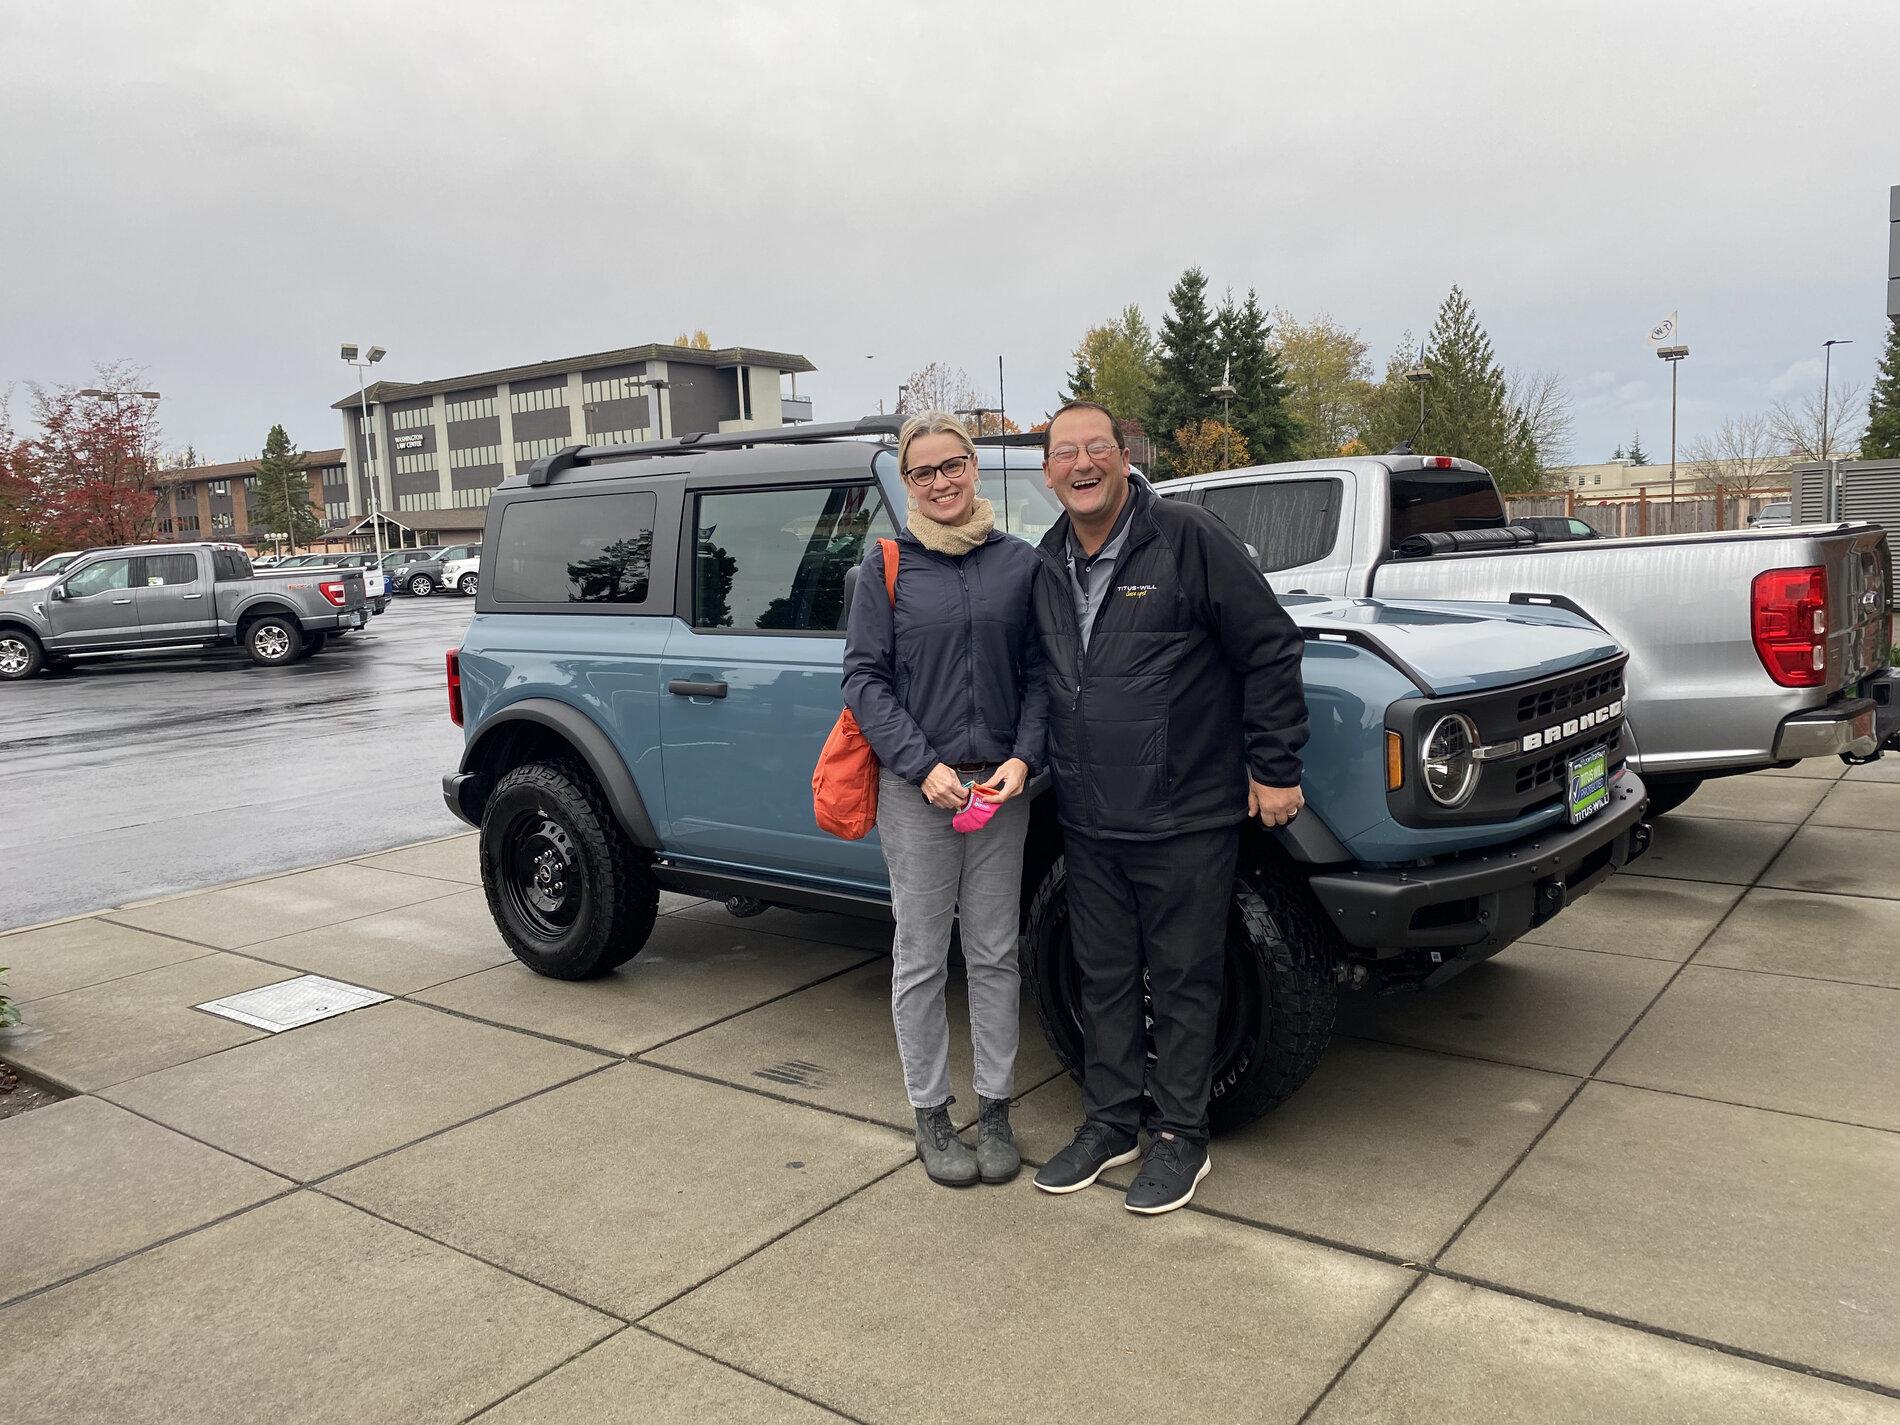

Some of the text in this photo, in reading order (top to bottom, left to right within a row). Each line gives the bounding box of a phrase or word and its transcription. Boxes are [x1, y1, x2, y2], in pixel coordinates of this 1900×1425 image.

[396, 440, 422, 450] LAW CENTER
[1117, 584, 1157, 592] TITUS-WILL
[1523, 700, 1622, 752] BRONCO
[1575, 795, 1610, 822] TITUS-WILL
